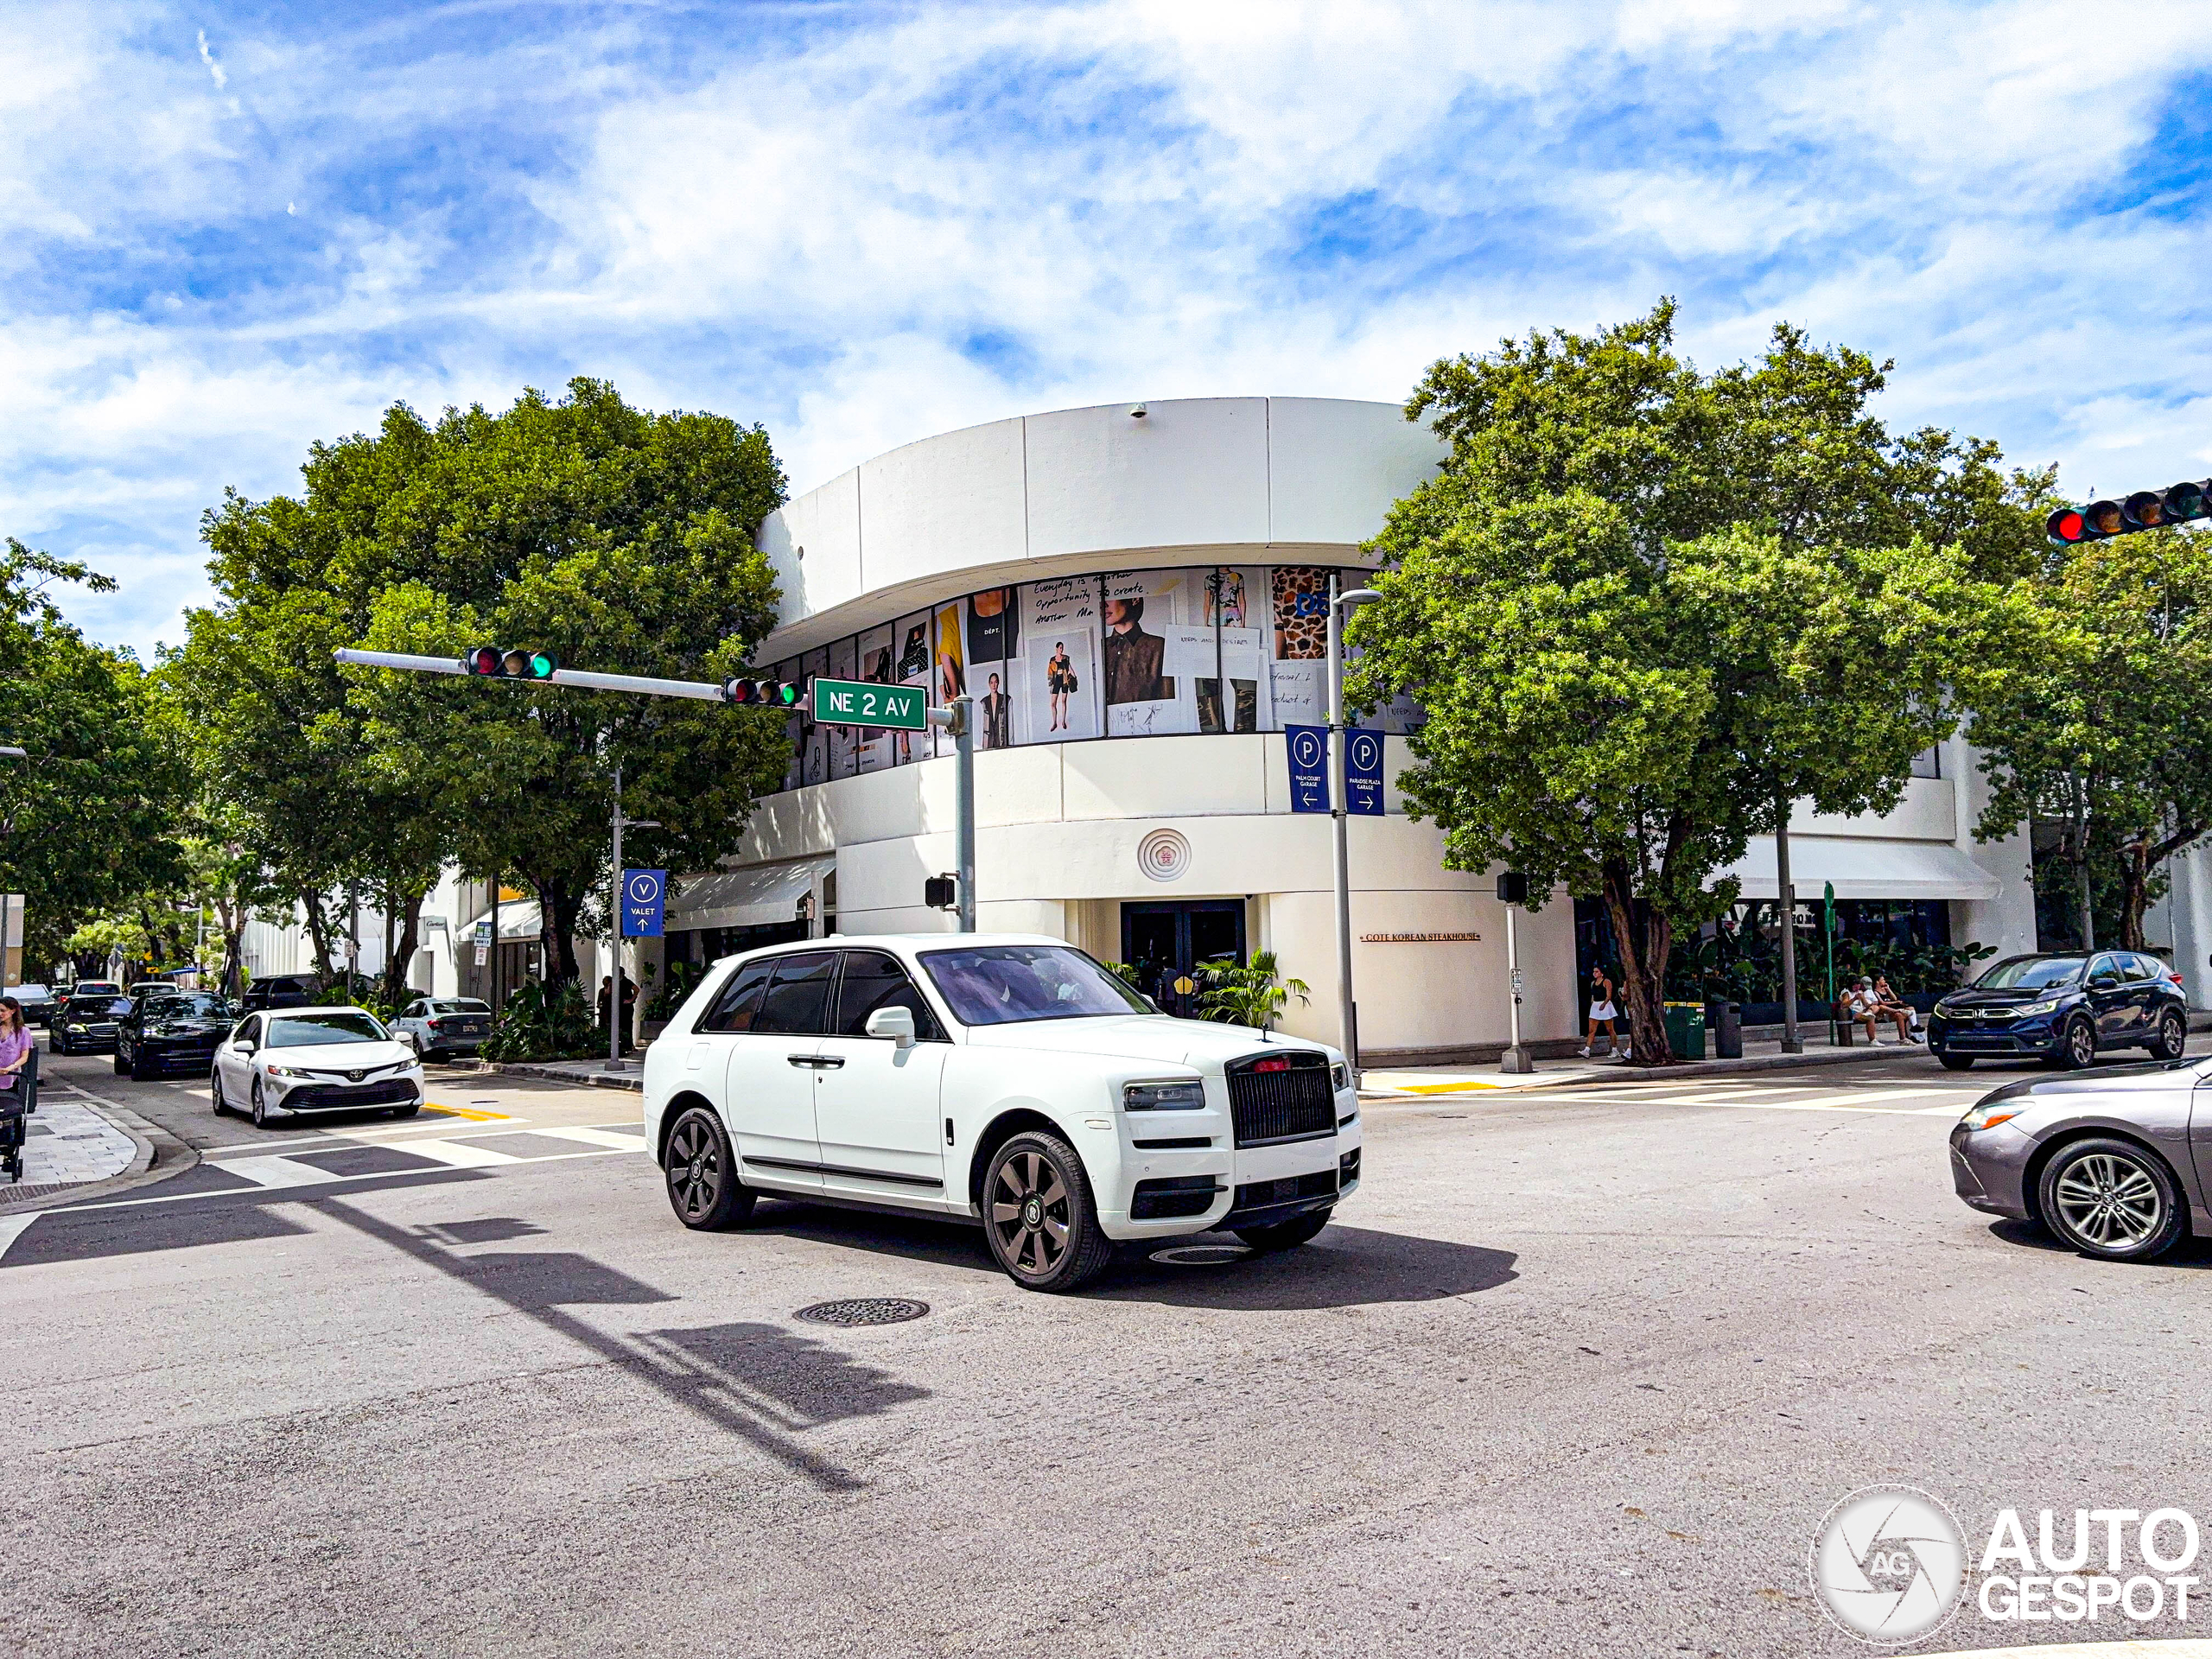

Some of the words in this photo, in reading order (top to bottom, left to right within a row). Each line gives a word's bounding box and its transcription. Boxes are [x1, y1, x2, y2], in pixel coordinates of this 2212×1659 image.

[830, 691, 854, 713] NE
[862, 693, 877, 716] 2
[885, 696, 911, 717] AV
[1302, 741, 1313, 760] P
[1361, 745, 1370, 762] P
[639, 883, 650, 896] V
[631, 907, 655, 916] VALET
[1365, 933, 1390, 942] COTE
[1392, 933, 1427, 942] KOREAN
[1428, 932, 1477, 941] STEAKHOUSE
